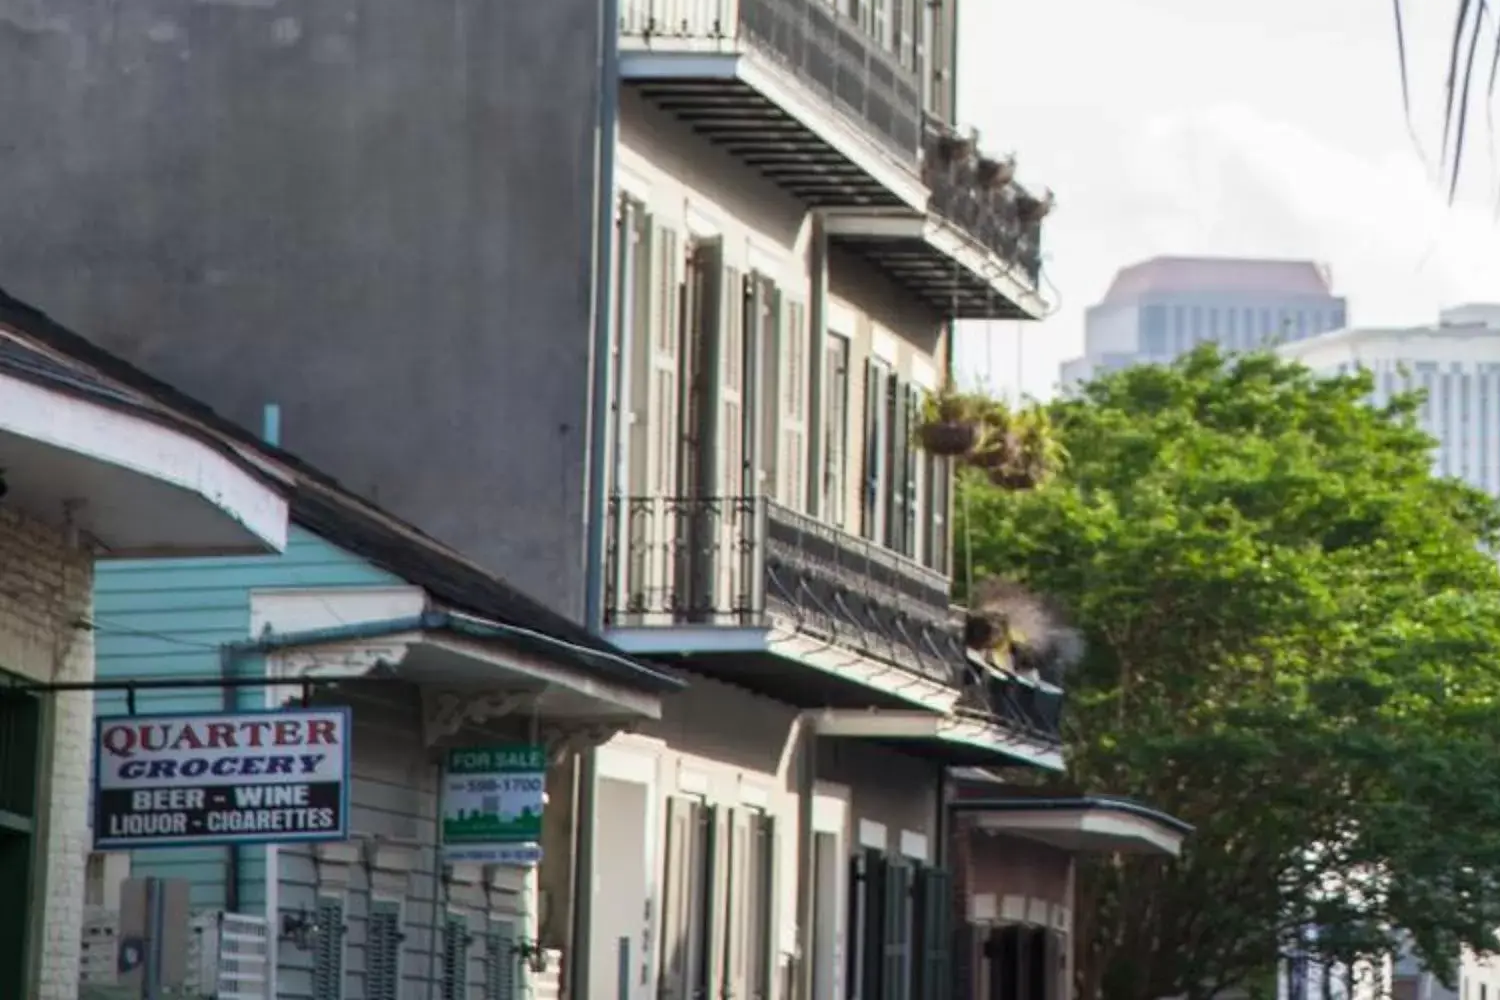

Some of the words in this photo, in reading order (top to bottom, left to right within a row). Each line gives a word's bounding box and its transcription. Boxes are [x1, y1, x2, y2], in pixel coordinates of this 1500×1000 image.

[103, 720, 338, 757] QUARTER
[118, 754, 325, 779] GROCERY
[453, 751, 491, 768] FOR
[495, 751, 541, 768] SALE
[131, 787, 206, 811] BEER
[233, 784, 310, 807] WINE
[109, 812, 188, 835] LIQUOR
[206, 808, 334, 832] CIGARETTES
